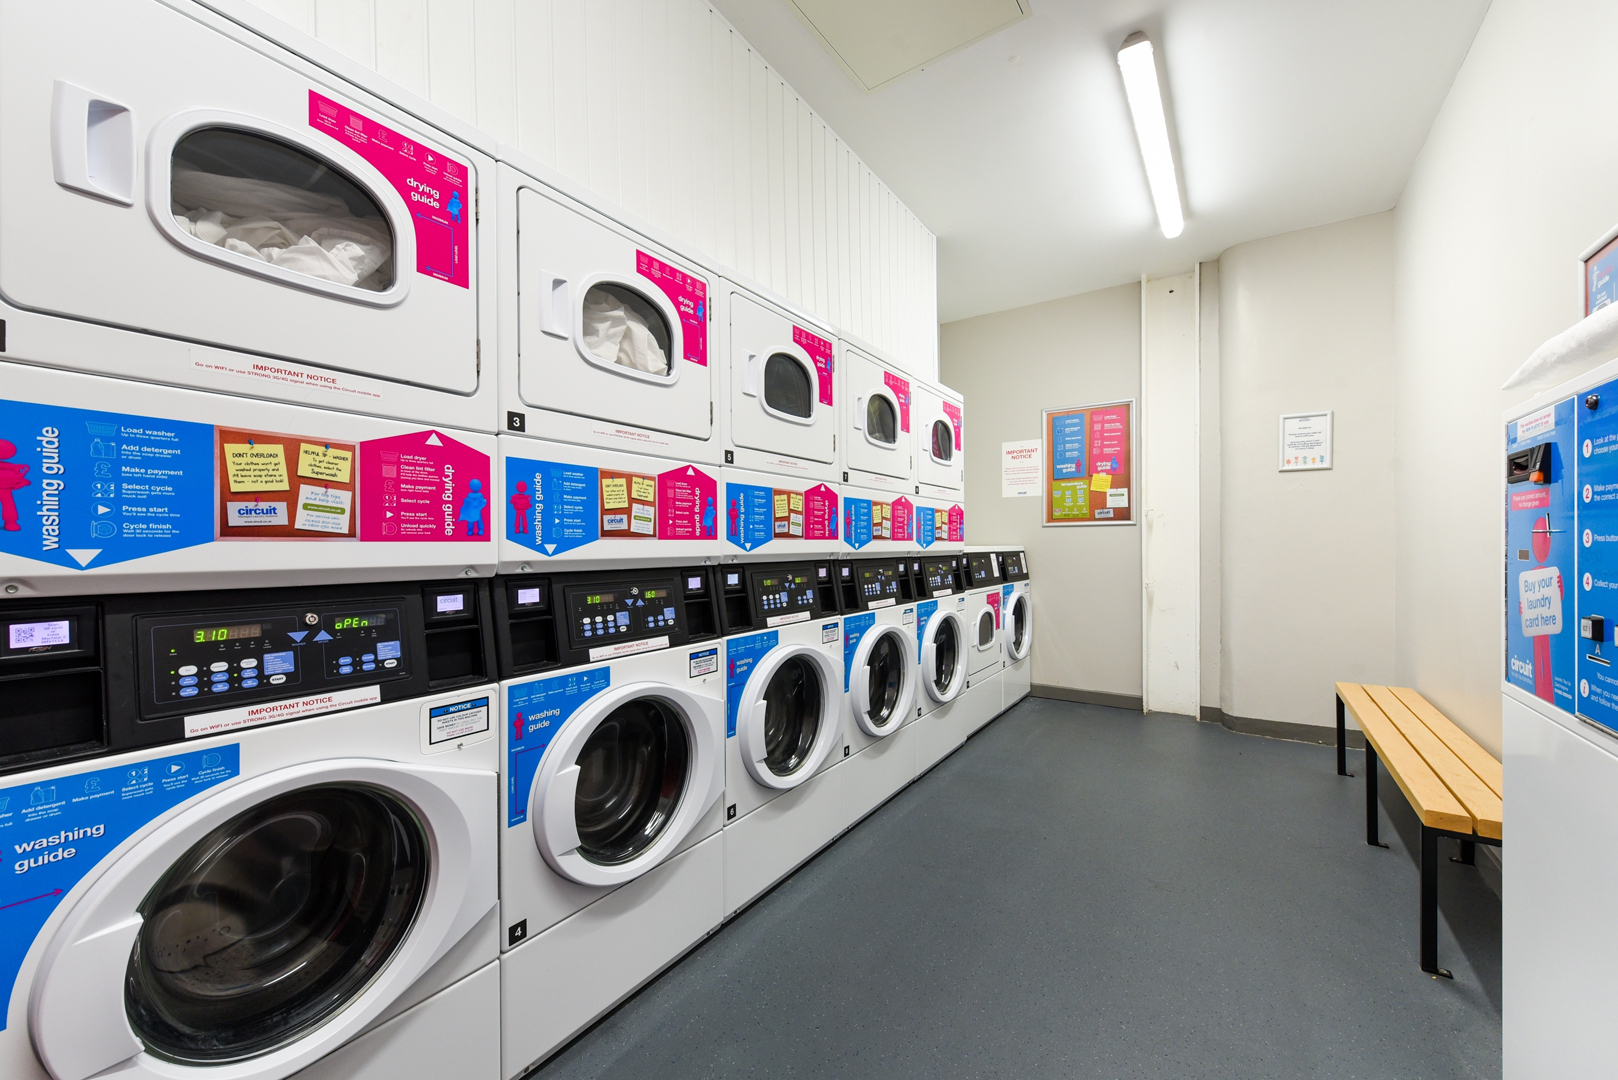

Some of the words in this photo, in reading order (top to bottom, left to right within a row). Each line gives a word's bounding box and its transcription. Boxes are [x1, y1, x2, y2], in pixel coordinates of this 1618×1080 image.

[406, 177, 440, 199] drying
[411, 191, 440, 209] guide
[678, 295, 694, 308] drying
[680, 304, 694, 315] guide
[247, 370, 271, 378] STRONG
[252, 364, 304, 378] IMPORTANT
[306, 373, 337, 384] NOTICE
[513, 417, 520, 427] 3
[121, 426, 143, 434] Load
[1594, 436, 1603, 445] Look
[1604, 435, 1608, 443] at
[36, 426, 65, 475] guide
[141, 446, 181, 455] detergent
[1594, 446, 1608, 455] choose
[311, 469, 338, 478] Superwash
[442, 464, 455, 501] drying
[534, 473, 544, 502] guide
[1594, 484, 1605, 492] Make
[1585, 488, 1590, 499] 2
[1601, 492, 1615, 500] correct
[36, 478, 65, 551] washing
[237, 506, 277, 516] circuit
[442, 504, 455, 536] guide
[533, 504, 544, 545] washing
[123, 522, 147, 530] Cycle
[1586, 532, 1589, 544] 3
[1594, 534, 1605, 542] Press
[1524, 580, 1536, 594] Buy
[1537, 576, 1553, 592] your
[1585, 576, 1590, 587] 4
[1594, 579, 1608, 588] Collect
[1527, 594, 1551, 610] laundry
[1525, 614, 1539, 628] card
[1540, 613, 1556, 626] here
[195, 628, 228, 643] 3.10
[1595, 644, 1601, 655] A
[736, 658, 753, 666] washing
[1511, 654, 1532, 678] circuit
[736, 665, 748, 674] guide
[1596, 672, 1604, 681] You
[1591, 683, 1602, 694] When
[248, 702, 300, 716] IMPORTANT
[302, 696, 333, 707] NOTICE
[450, 702, 471, 712] NOTICE
[1599, 696, 1610, 708] follow
[242, 716, 267, 724] STRONG
[528, 708, 560, 721] washing
[528, 720, 550, 733] guide
[90, 790, 115, 800] payment
[36, 801, 66, 811] detergent
[730, 808, 735, 816] 6
[14, 824, 105, 854] washing
[14, 848, 76, 875] guide
[515, 926, 522, 937] 4
